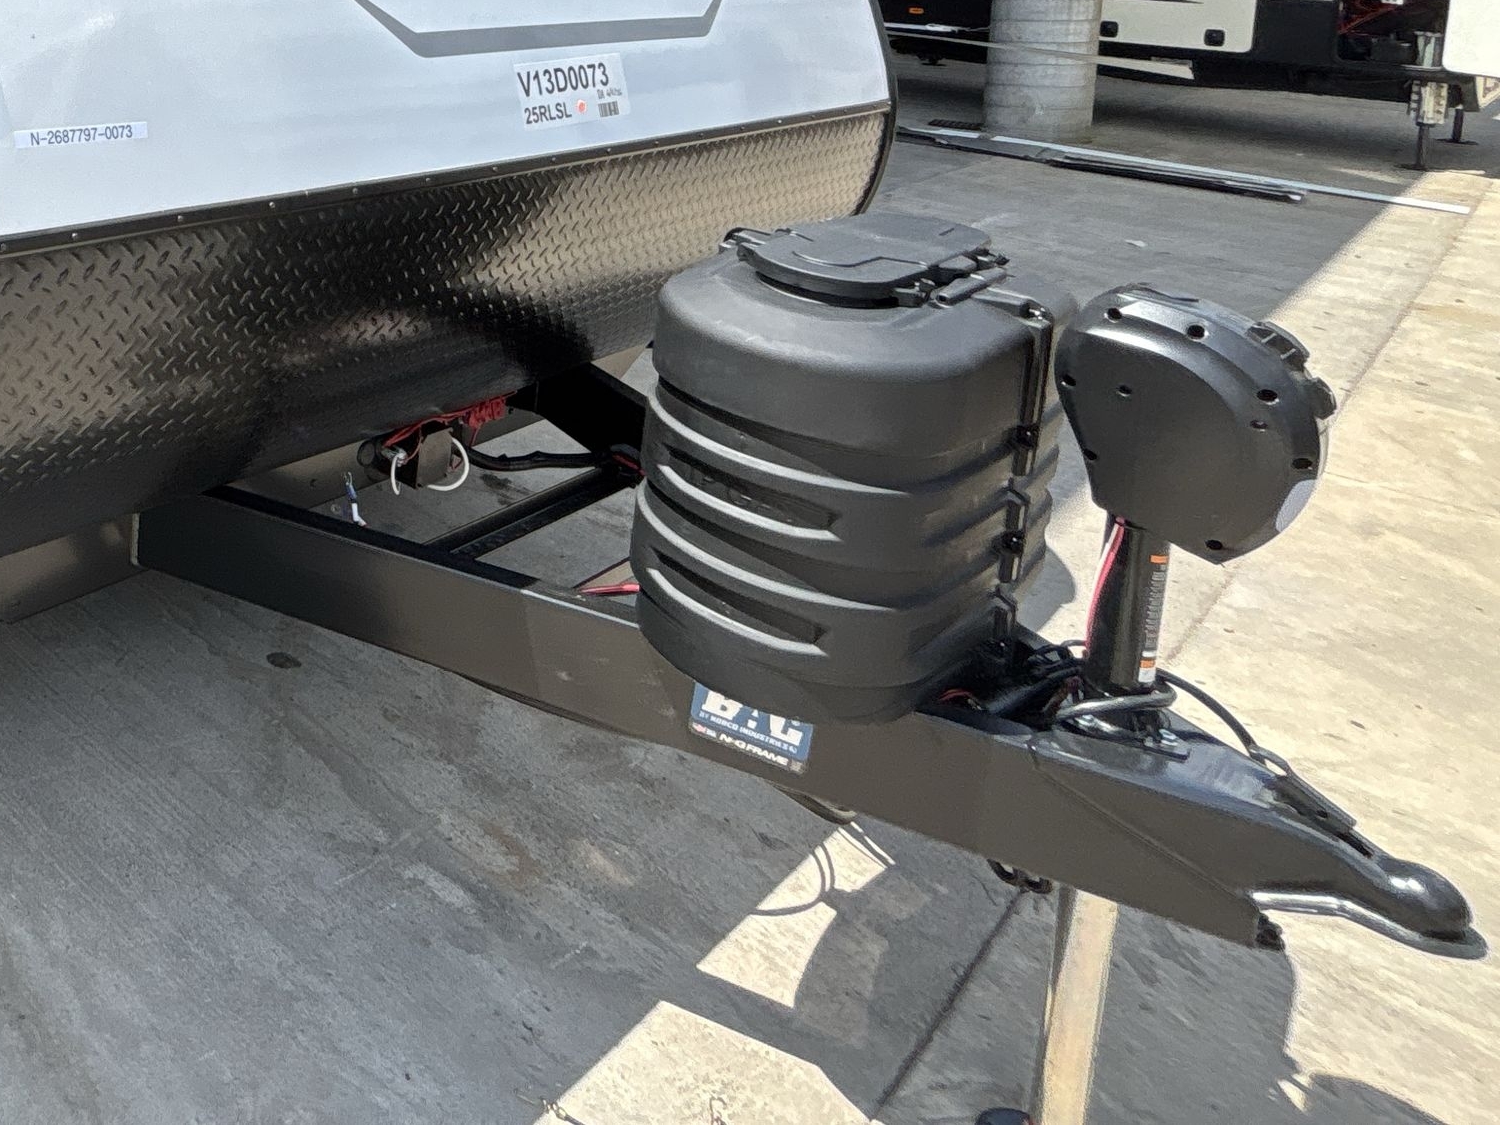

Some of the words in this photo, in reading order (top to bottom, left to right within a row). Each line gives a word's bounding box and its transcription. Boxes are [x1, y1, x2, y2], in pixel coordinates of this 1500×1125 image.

[517, 62, 609, 97] V13D0073
[524, 102, 572, 124] 25RLSL
[30, 124, 133, 146] N-2687797-0073
[710, 716, 738, 730] NORCO
[739, 726, 789, 751] INDUSTRIES
[746, 743, 789, 766] FRAME
